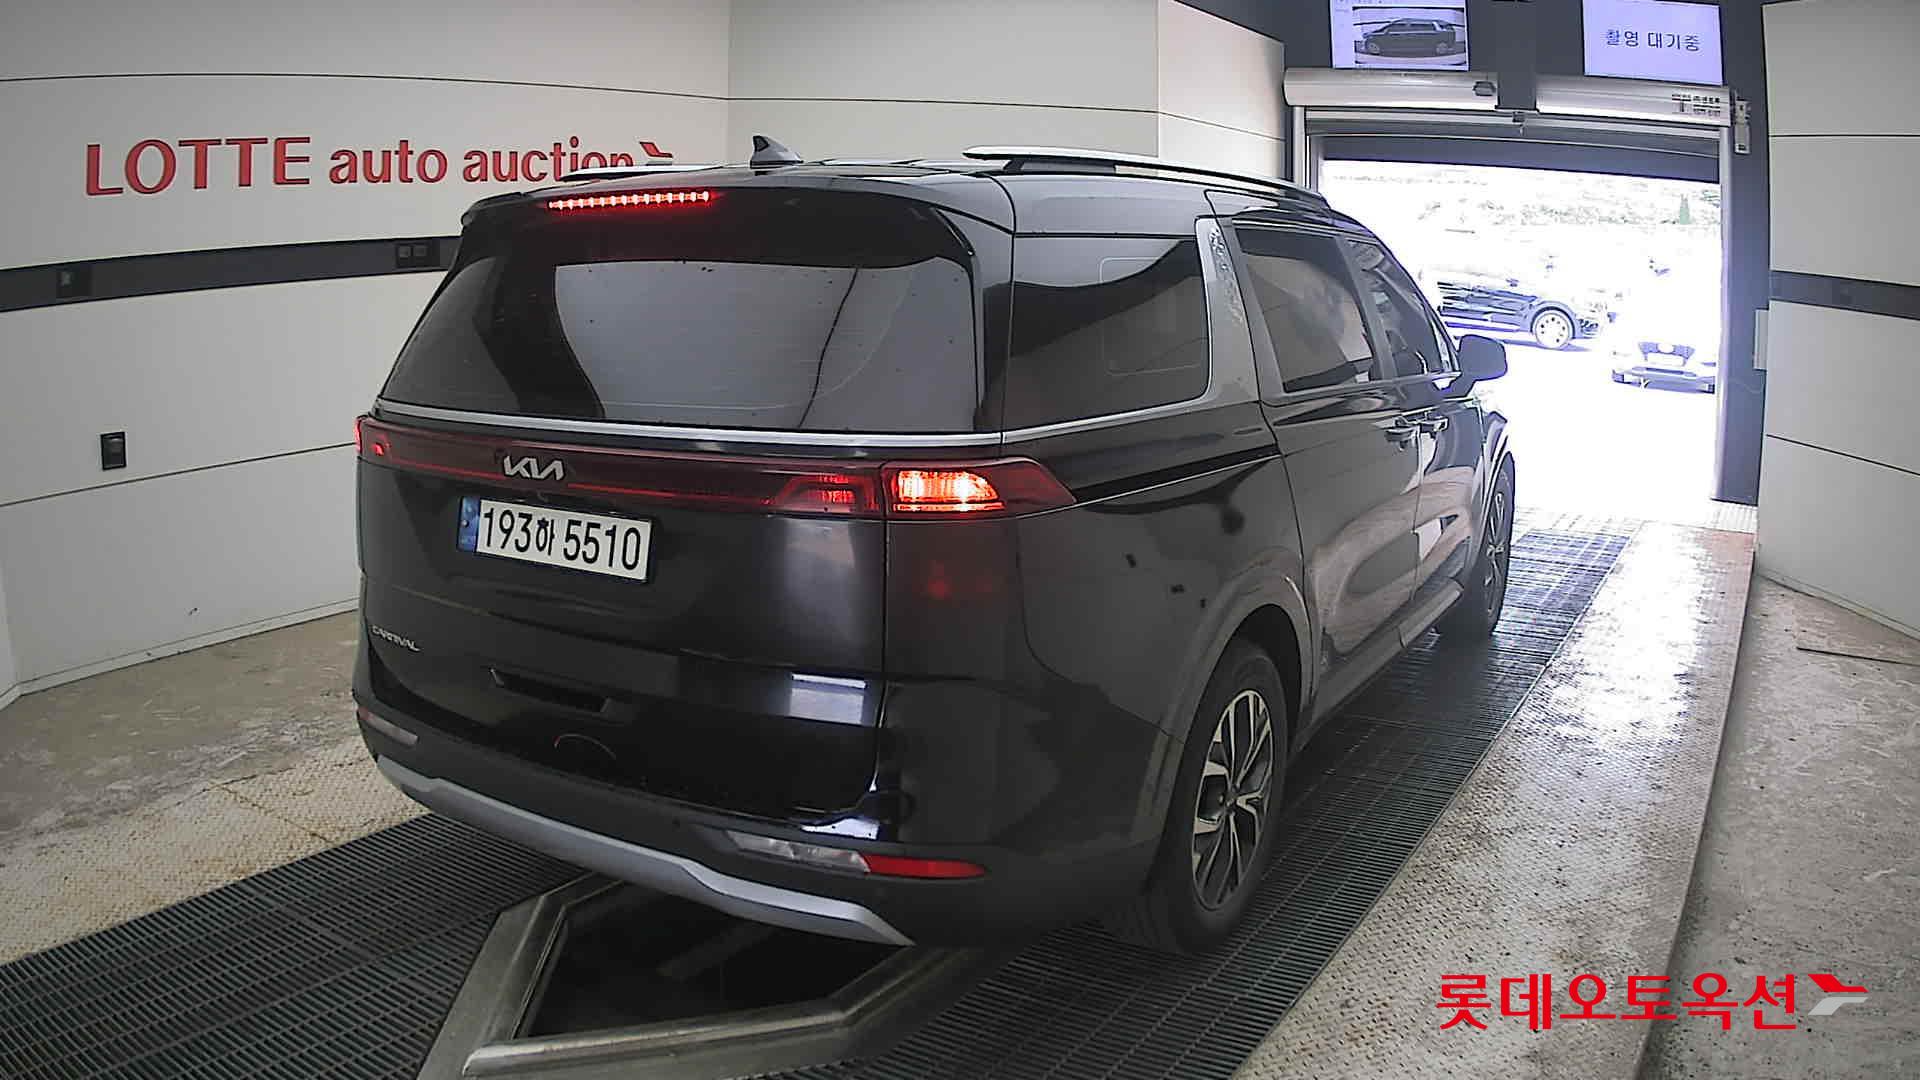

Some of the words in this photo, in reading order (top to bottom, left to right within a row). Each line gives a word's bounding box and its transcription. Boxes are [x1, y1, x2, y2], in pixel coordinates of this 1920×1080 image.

[1647, 31, 1699, 52] 대기중
[86, 136, 311, 196] LOTTE
[328, 139, 448, 184] auto
[503, 455, 565, 481] KIA
[563, 519, 641, 570] 5510
